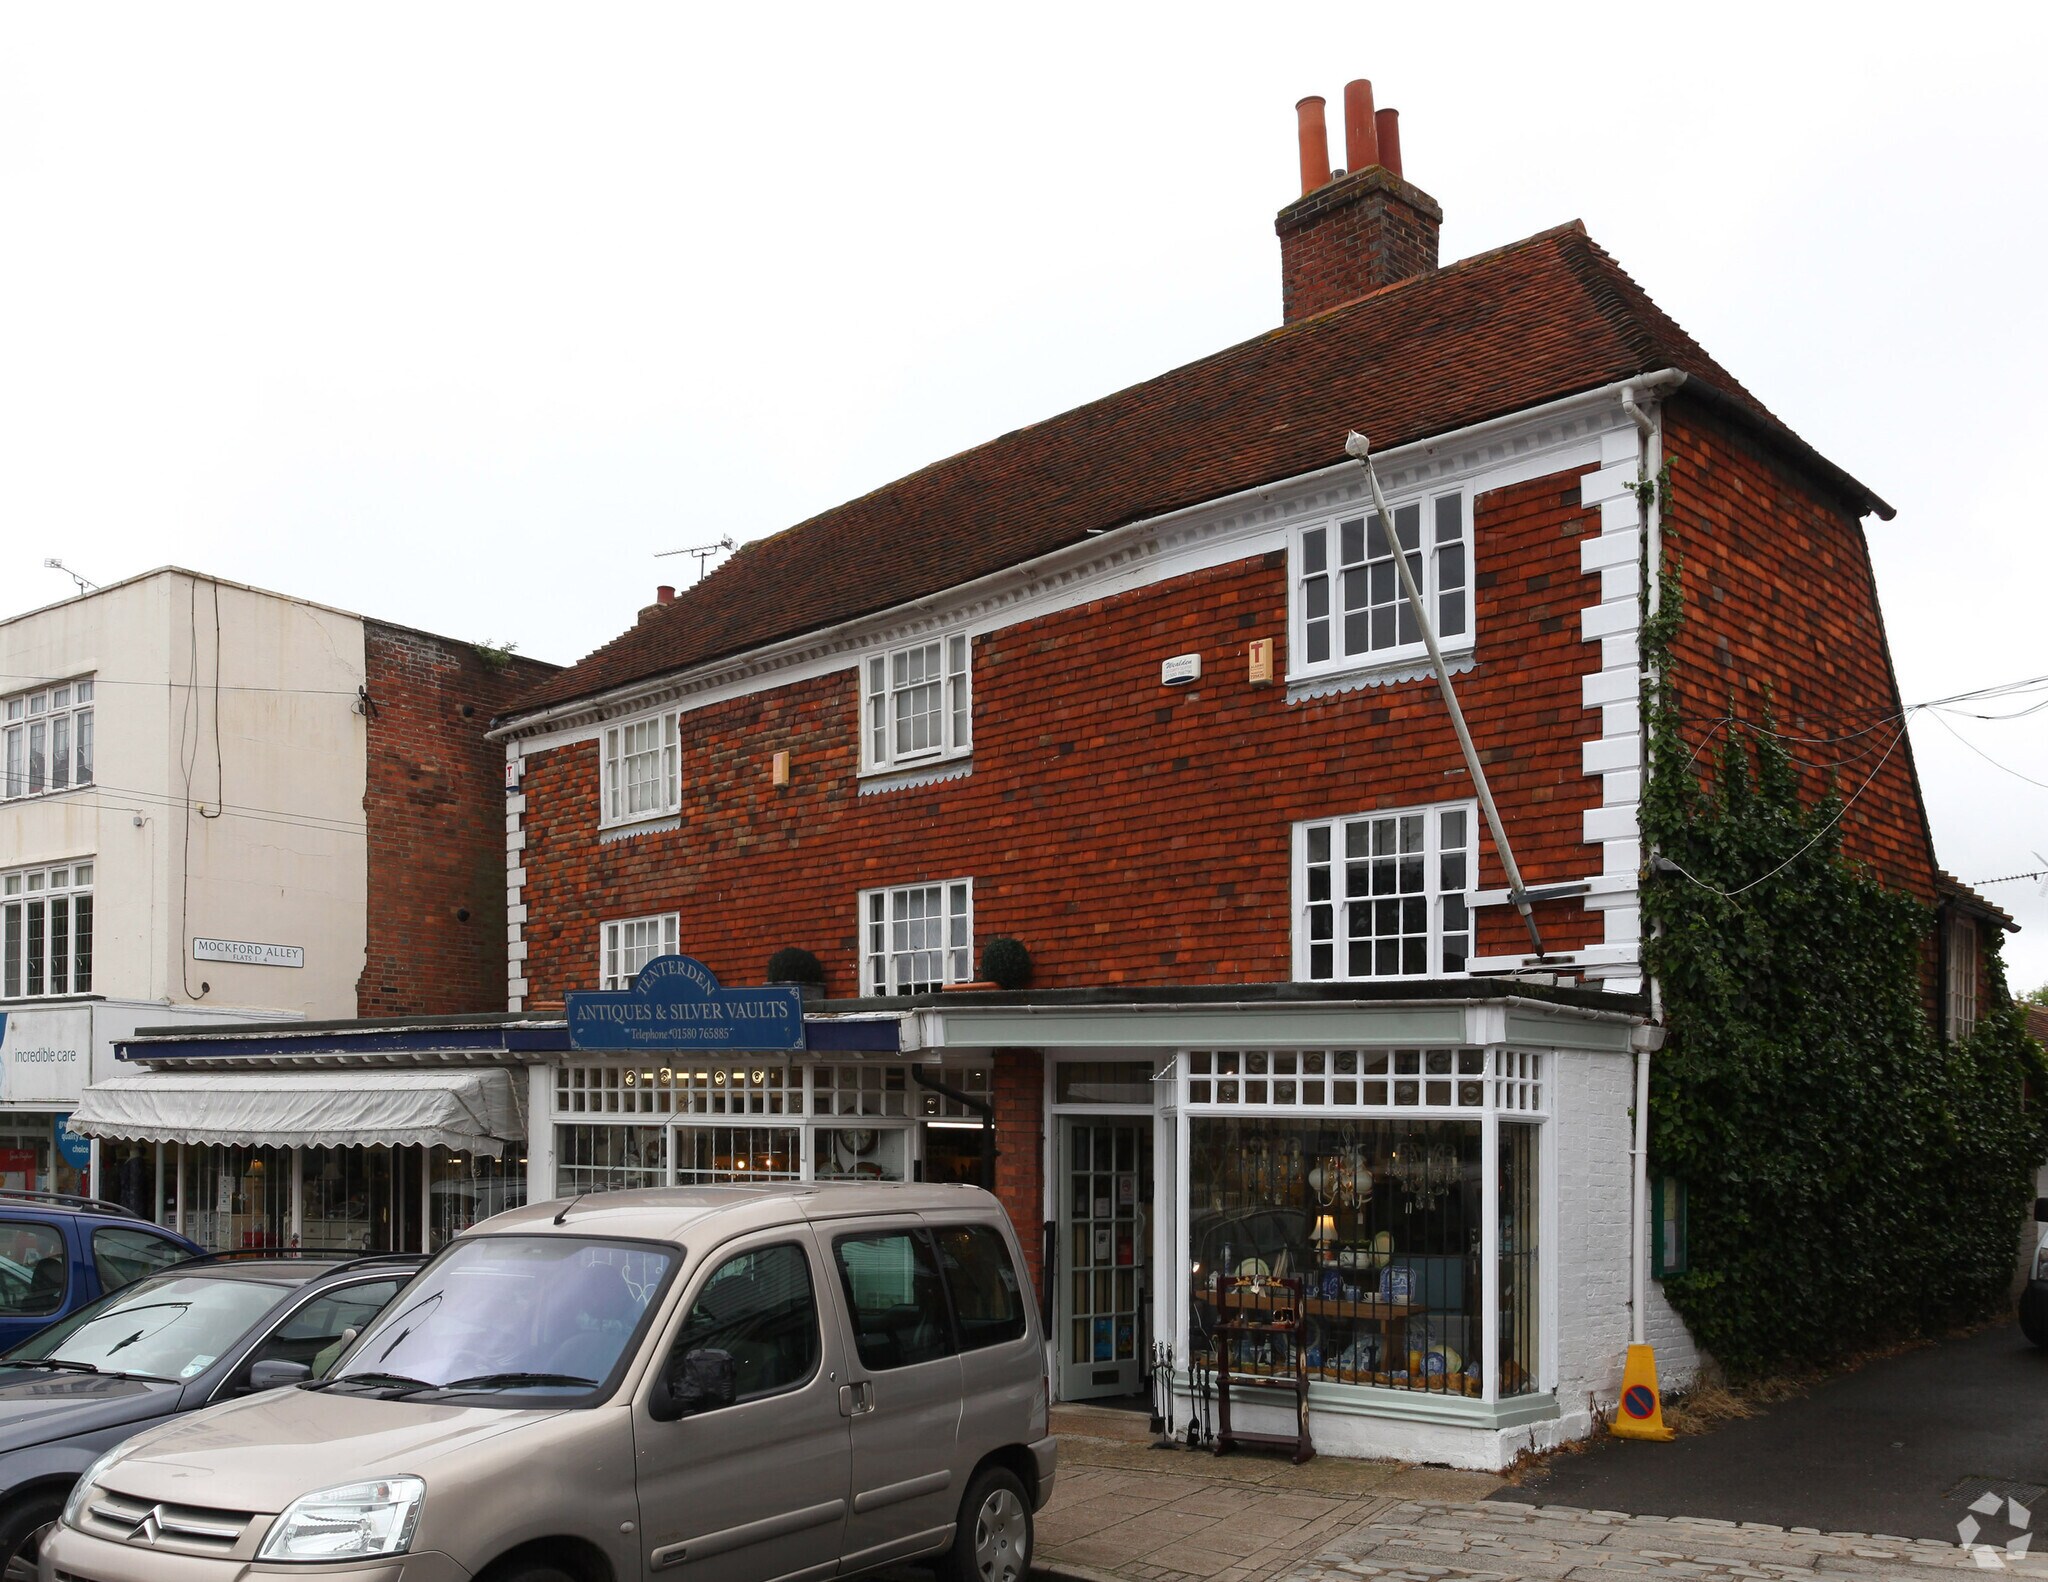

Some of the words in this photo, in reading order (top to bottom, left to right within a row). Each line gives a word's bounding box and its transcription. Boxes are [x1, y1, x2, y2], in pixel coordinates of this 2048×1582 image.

[198, 941, 262, 955] MOCKFORD
[266, 947, 299, 959] ALLEY
[233, 953, 252, 962] FLATS
[636, 960, 716, 996] TENTERDEN
[577, 1004, 652, 1024] ANTIQUES
[656, 1003, 667, 1020] &
[670, 1002, 723, 1020] SILVER
[725, 1001, 788, 1019] VAULTS
[671, 1028, 697, 1039] 01580
[699, 1027, 729, 1039] 765885
[15, 1048, 55, 1062] incredible
[57, 1050, 76, 1062] care
[72, 1145, 89, 1153] choice
